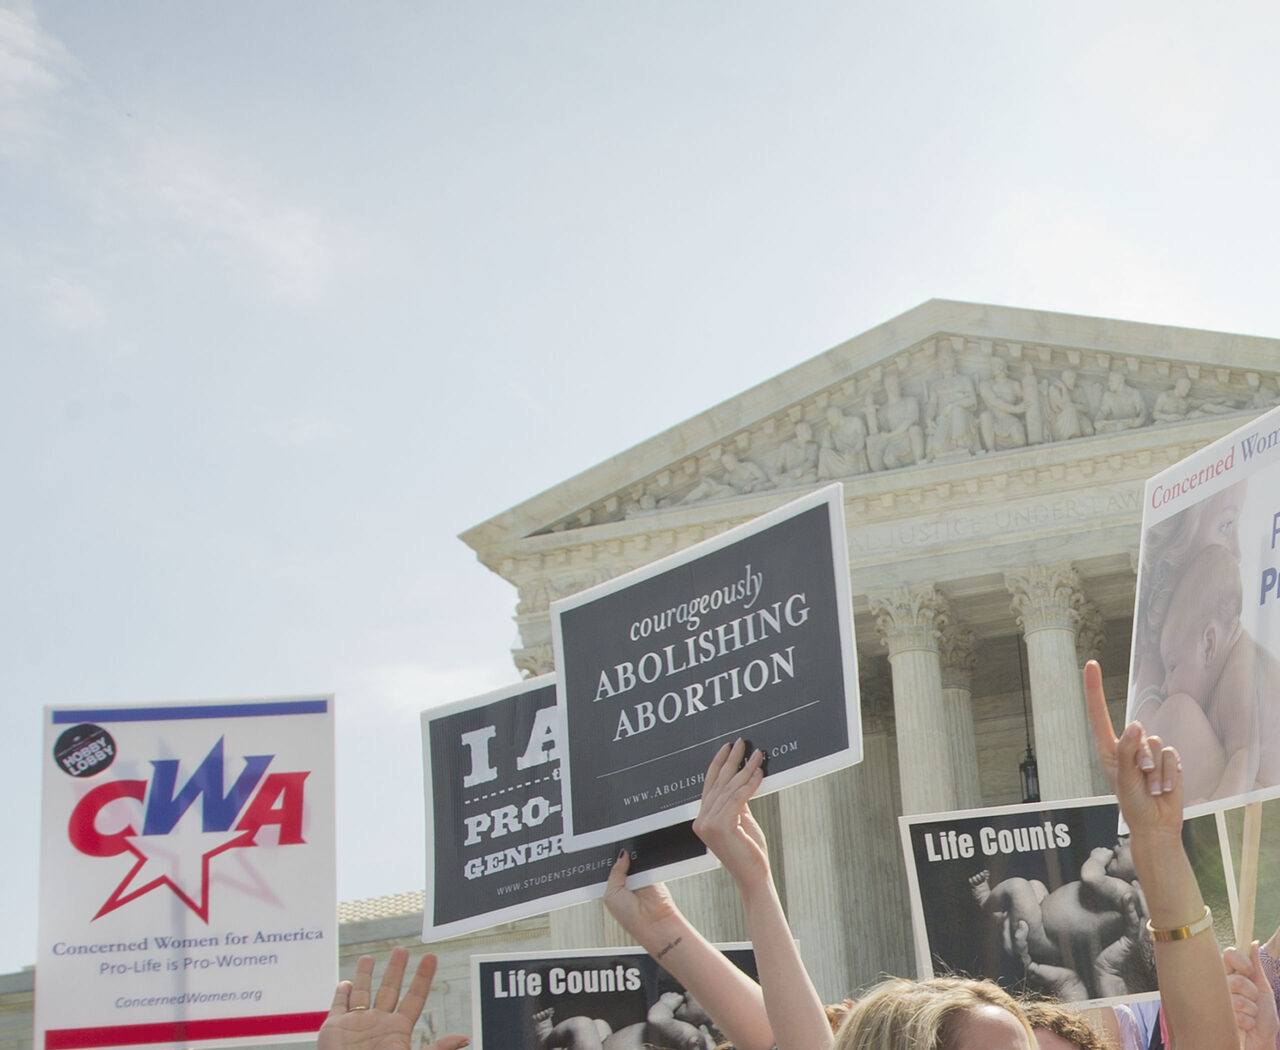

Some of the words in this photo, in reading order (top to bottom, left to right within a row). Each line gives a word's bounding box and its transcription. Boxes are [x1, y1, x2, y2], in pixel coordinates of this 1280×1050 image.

[1152, 446, 1235, 510] Concerned
[889, 517, 983, 547] JUSTICE
[995, 500, 1082, 530] UNDER
[630, 564, 763, 642] courageously
[593, 592, 811, 703] ABOLISHING
[612, 646, 797, 742] ABORTION
[62, 737, 107, 768] HOBBY
[69, 745, 114, 776] LOBBY
[461, 725, 498, 788] I
[517, 705, 561, 770] A
[68, 734, 312, 858] CWA
[464, 796, 561, 846] PRO-
[925, 830, 974, 863] Life
[979, 821, 1071, 857] Counts
[464, 832, 567, 880] GENER
[52, 938, 148, 957] Concerned
[154, 933, 218, 950] Women
[225, 931, 247, 946] for
[254, 928, 324, 944] America
[100, 957, 161, 976] Pro-Life
[166, 955, 179, 972] is
[183, 953, 278, 971] Pro-Women
[115, 988, 262, 1009] ConcernedWomen.org
[494, 969, 542, 999] Life
[549, 965, 641, 996] Counts
